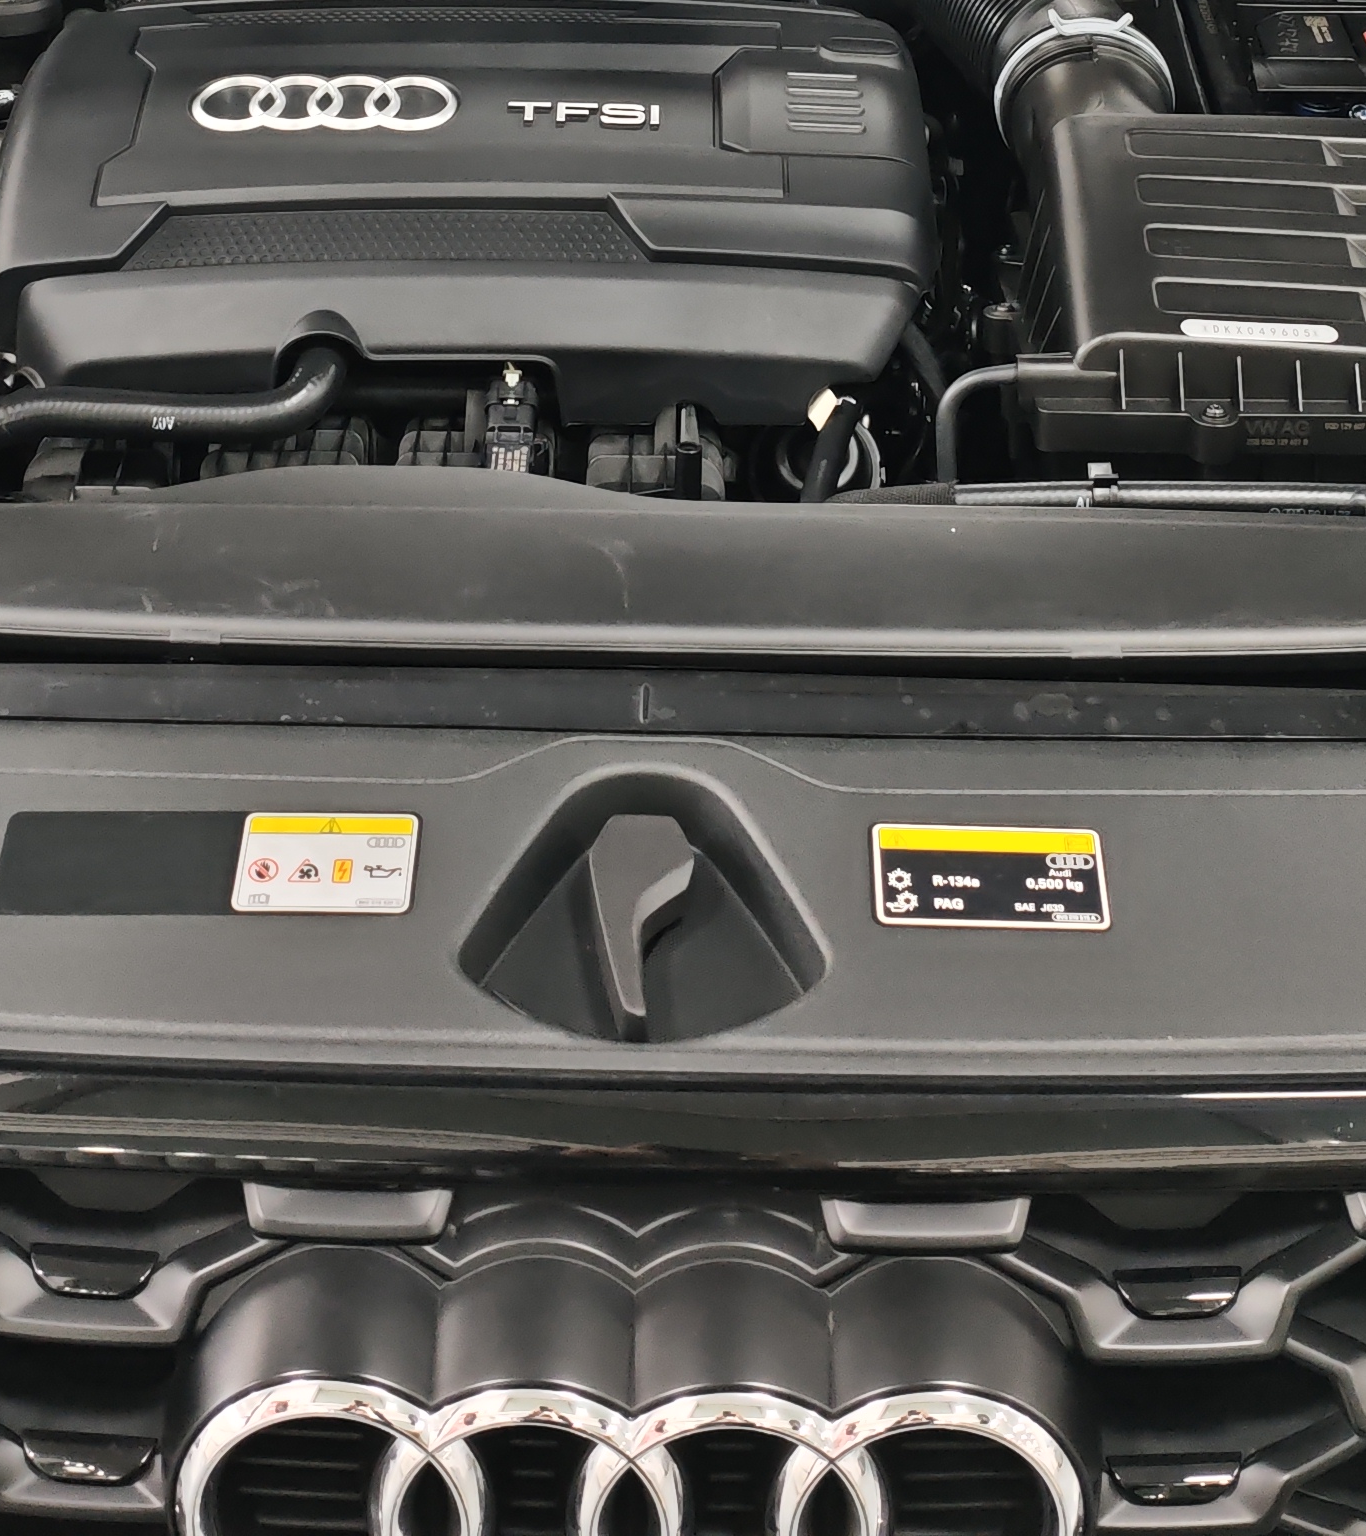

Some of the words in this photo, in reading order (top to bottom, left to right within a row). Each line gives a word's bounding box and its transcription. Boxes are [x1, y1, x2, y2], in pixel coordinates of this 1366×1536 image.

[507, 99, 662, 130] TFSI
[1048, 868, 1073, 878] Audi
[932, 874, 981, 889] R-134a
[1025, 877, 1064, 891] 0,500
[1066, 878, 1084, 893] kg
[933, 897, 964, 911] PAG
[1014, 902, 1037, 913] SAE
